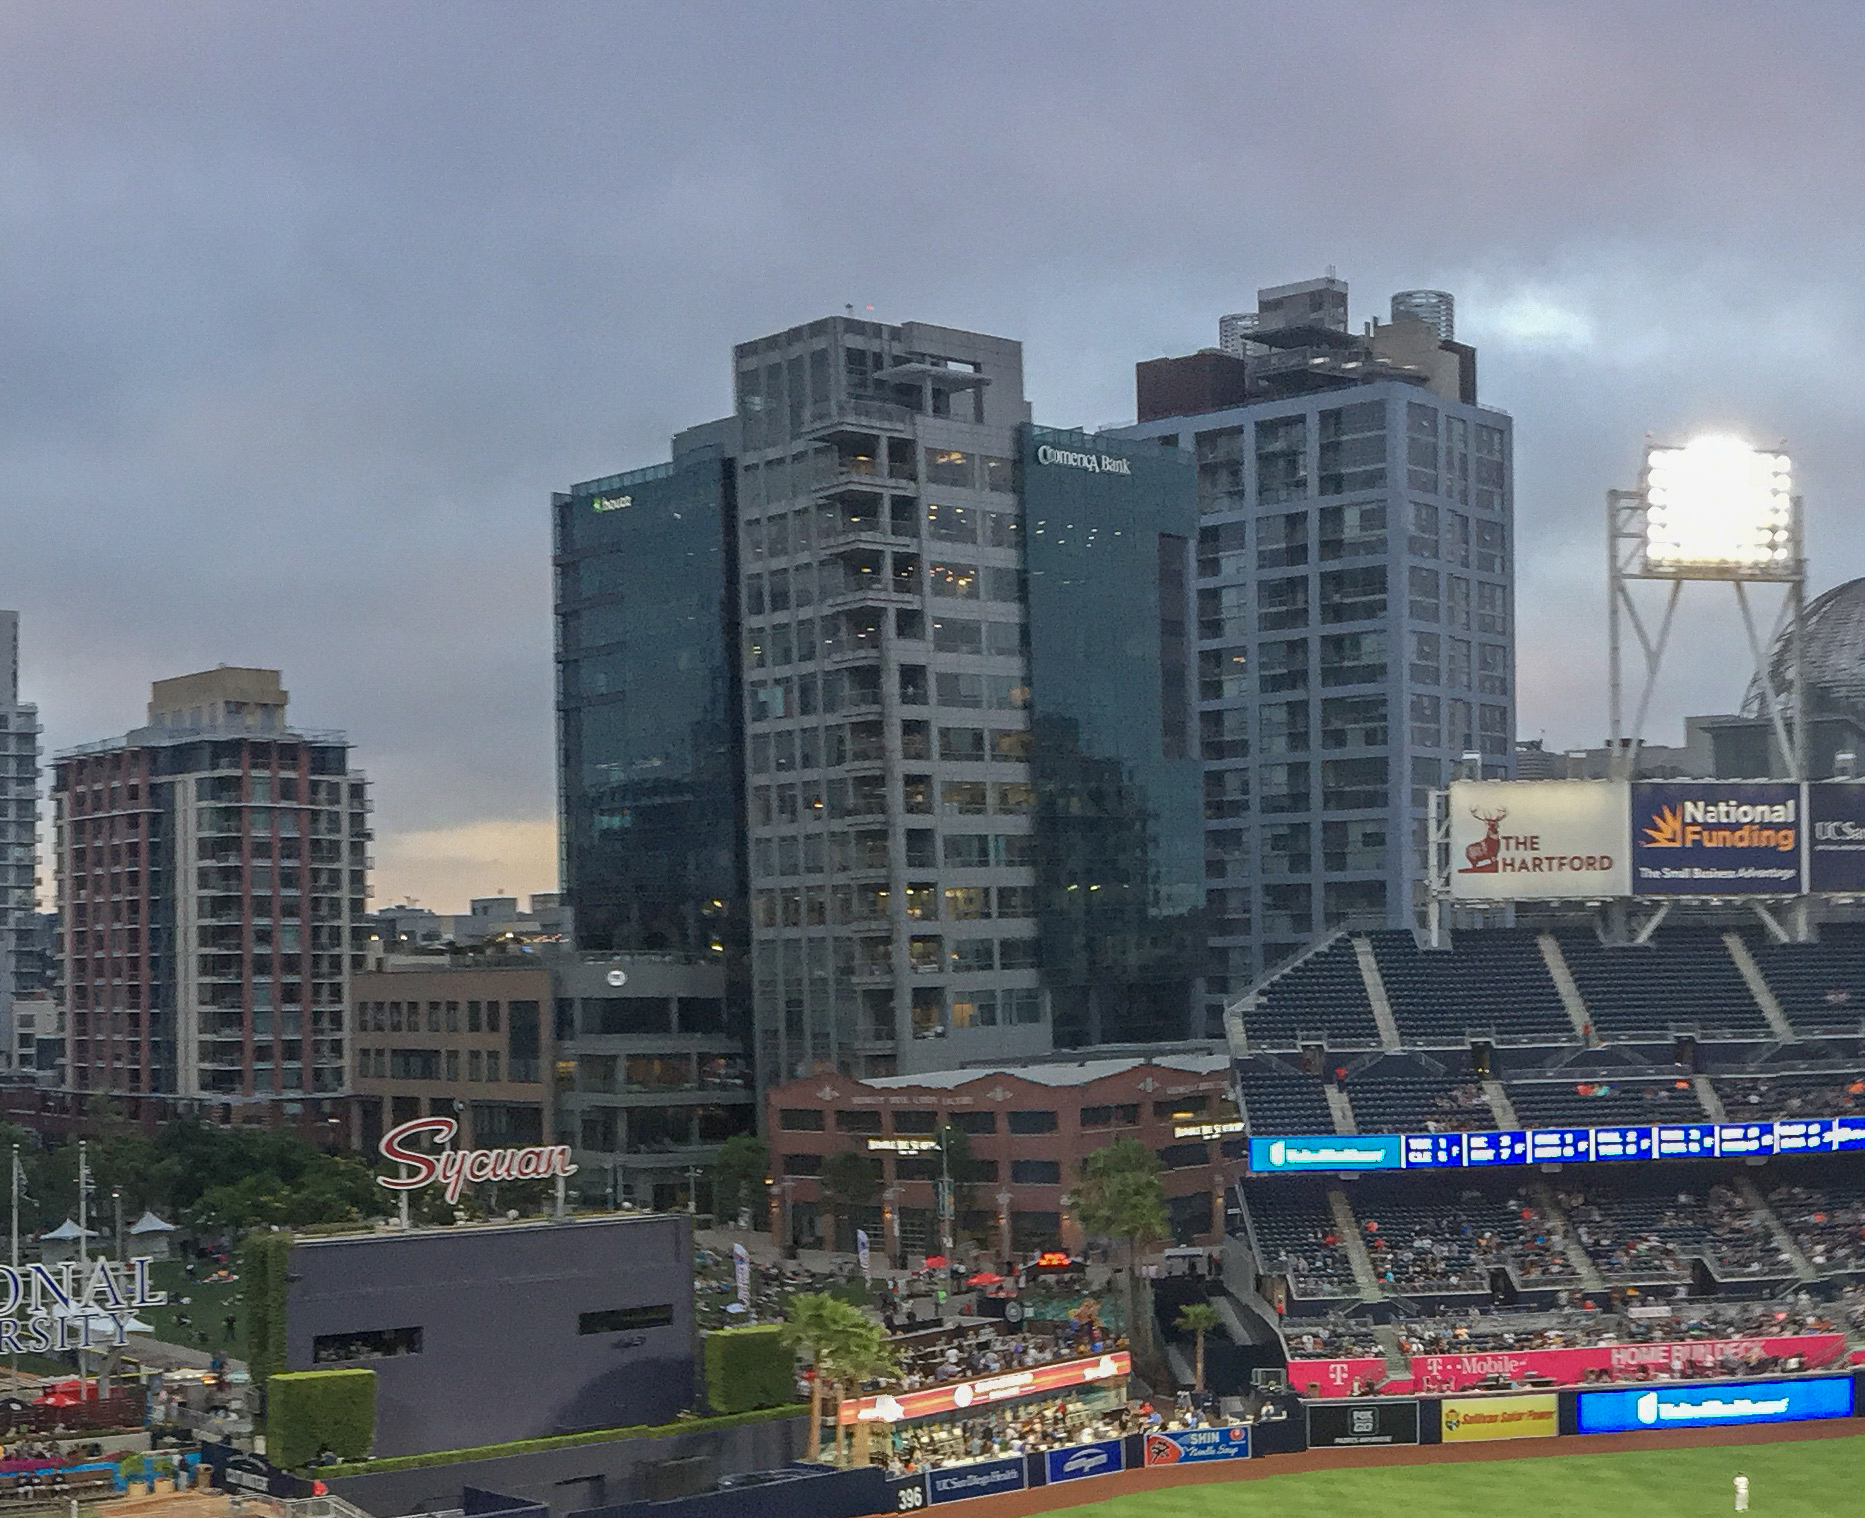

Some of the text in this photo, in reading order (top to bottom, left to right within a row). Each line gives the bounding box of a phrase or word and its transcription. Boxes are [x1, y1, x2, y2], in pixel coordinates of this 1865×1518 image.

[1101, 455, 1133, 475] Bank
[1683, 801, 1795, 825] National
[1684, 825, 1796, 851] Funding
[1815, 821, 1842, 841] UC
[1501, 835, 1540, 851] THE
[1501, 855, 1614, 873] HARTFORD
[376, 1117, 579, 1205] Sycuan
[1611, 1346, 1670, 1366] HOME
[1329, 1364, 1349, 1386] T
[1189, 1431, 1220, 1445] SHIN
[898, 1486, 923, 1511] 396
